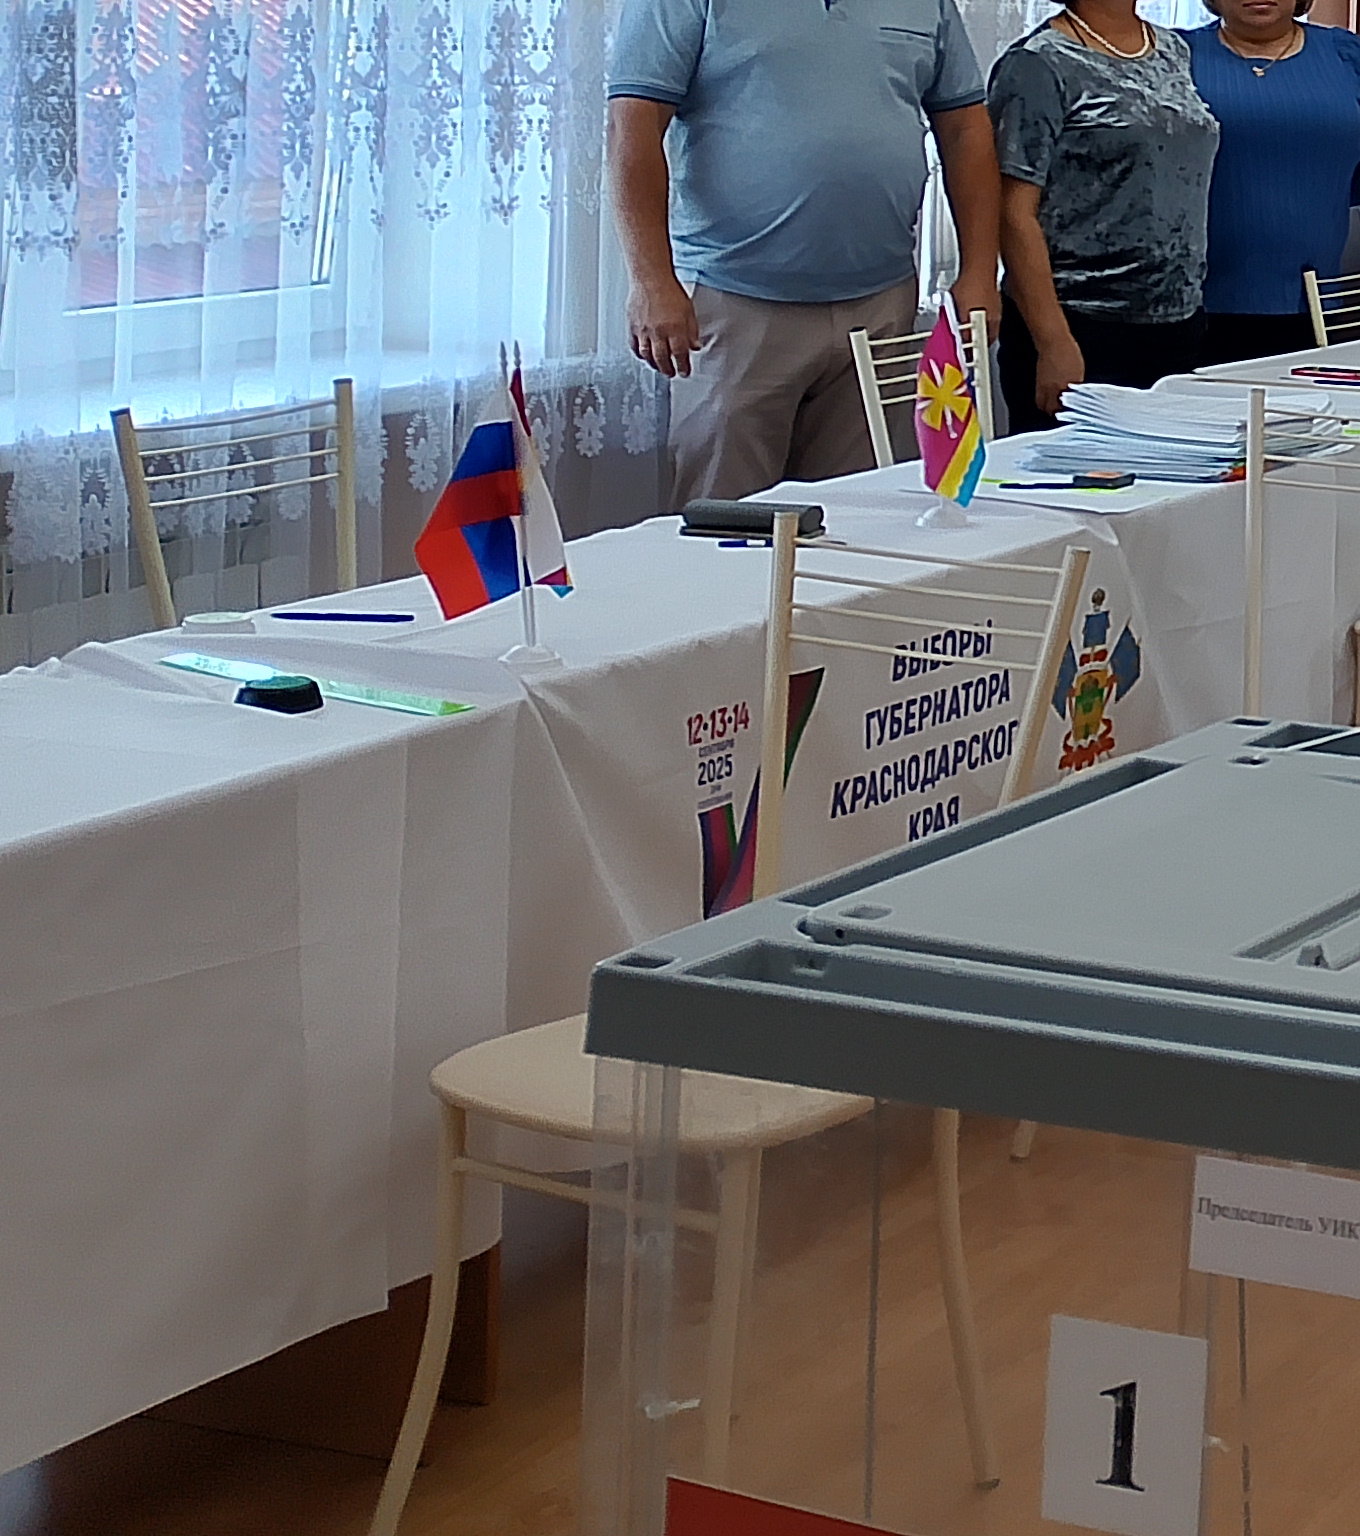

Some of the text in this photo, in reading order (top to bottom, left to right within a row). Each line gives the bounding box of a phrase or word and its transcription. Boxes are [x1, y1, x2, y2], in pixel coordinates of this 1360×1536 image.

[892, 619, 992, 682] ВЫБОРЫ
[865, 669, 1010, 749] ГУБЕРНАТОРА
[698, 753, 732, 786] 2025
[830, 720, 1018, 819] КРАСНОДАРСКОГ
[908, 795, 960, 842] КРАЯ
[1198, 1196, 1313, 1233] Председатель
[1317, 1216, 1360, 1241] УИК
[1096, 1382, 1145, 1492] 1
